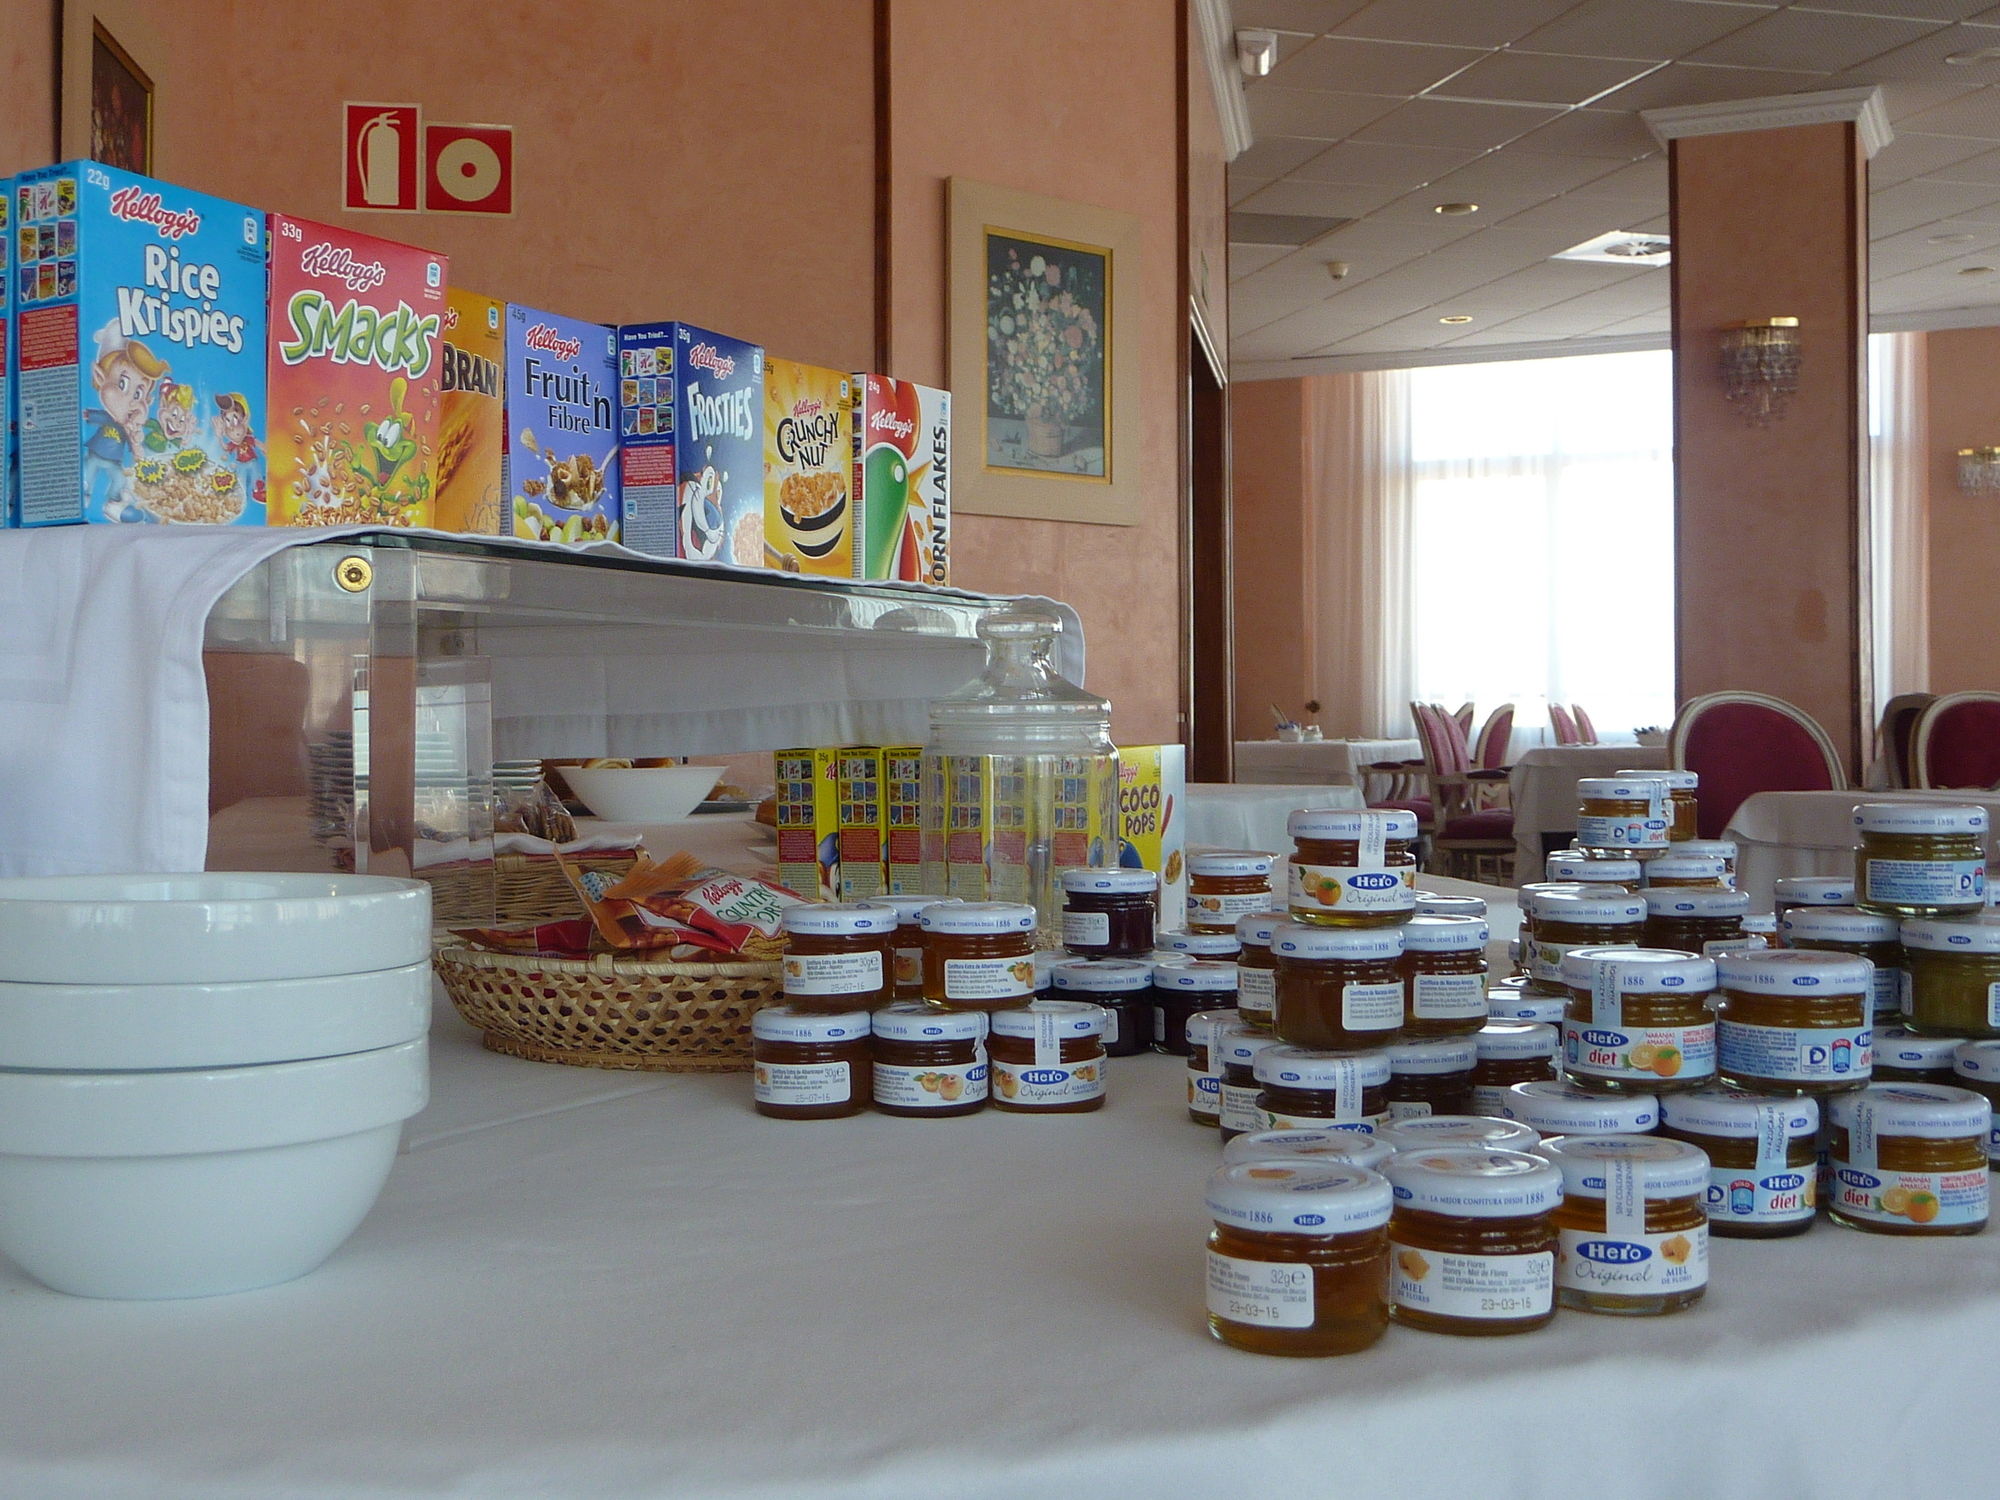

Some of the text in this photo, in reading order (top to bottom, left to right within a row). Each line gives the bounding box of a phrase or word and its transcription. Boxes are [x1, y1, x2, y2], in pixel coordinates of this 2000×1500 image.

[87, 168, 110, 190] 22g
[111, 186, 200, 240] Kellogg's
[281, 222, 302, 243] 33g
[145, 244, 220, 300] Rice
[301, 244, 386, 291] Kellogg's
[118, 287, 245, 353] Krispies
[512, 309, 526, 324] 45g
[526, 323, 582, 362] Kellogg's
[679, 328, 691, 343] 35g
[441, 341, 498, 398] BRAN
[689, 342, 736, 380] Kellogg's
[868, 380, 881, 394] 24g
[687, 380, 753, 442] FROSTIES
[792, 398, 822, 417] Kellogg's
[548, 404, 592, 435] Fibre
[870, 408, 914, 439] Kellogg's
[777, 411, 840, 464] CRUNCHY
[799, 442, 829, 471] NUT
[932, 425, 947, 584] ORN FLAKES
[1120, 783, 1160, 813] COCO
[1126, 812, 1155, 837] POPS
[1348, 823, 1362, 832] 188
[1354, 874, 1395, 888] Hero
[716, 882, 778, 923] COUNTRY
[1345, 889, 1398, 907] Original
[1624, 976, 1645, 986] 1886
[1754, 974, 1775, 984] 1886
[1585, 1031, 1623, 1046] Hero
[1588, 1048, 1617, 1066] diet
[1026, 1070, 1065, 1083] Hero
[1200, 1079, 1219, 1091] He
[1020, 1082, 1071, 1100] Original
[1598, 1119, 1619, 1128] 1886
[1766, 1174, 1802, 1190] Hero
[1840, 1169, 1875, 1188] Hero
[1440, 1196, 1461, 1204] MEJOR
[1462, 1197, 1503, 1206] CONFITURA
[1525, 1192, 1545, 1204] 1886
[1770, 1192, 1797, 1210] diet
[1843, 1188, 1871, 1207] diet
[1249, 1210, 1273, 1224] 1886
[1296, 1214, 1324, 1226] Hero
[1585, 1243, 1645, 1261] Hero
[1575, 1261, 1653, 1286] Original
[1666, 1266, 1688, 1277] MIEL
[1400, 1281, 1424, 1294] MIEL
